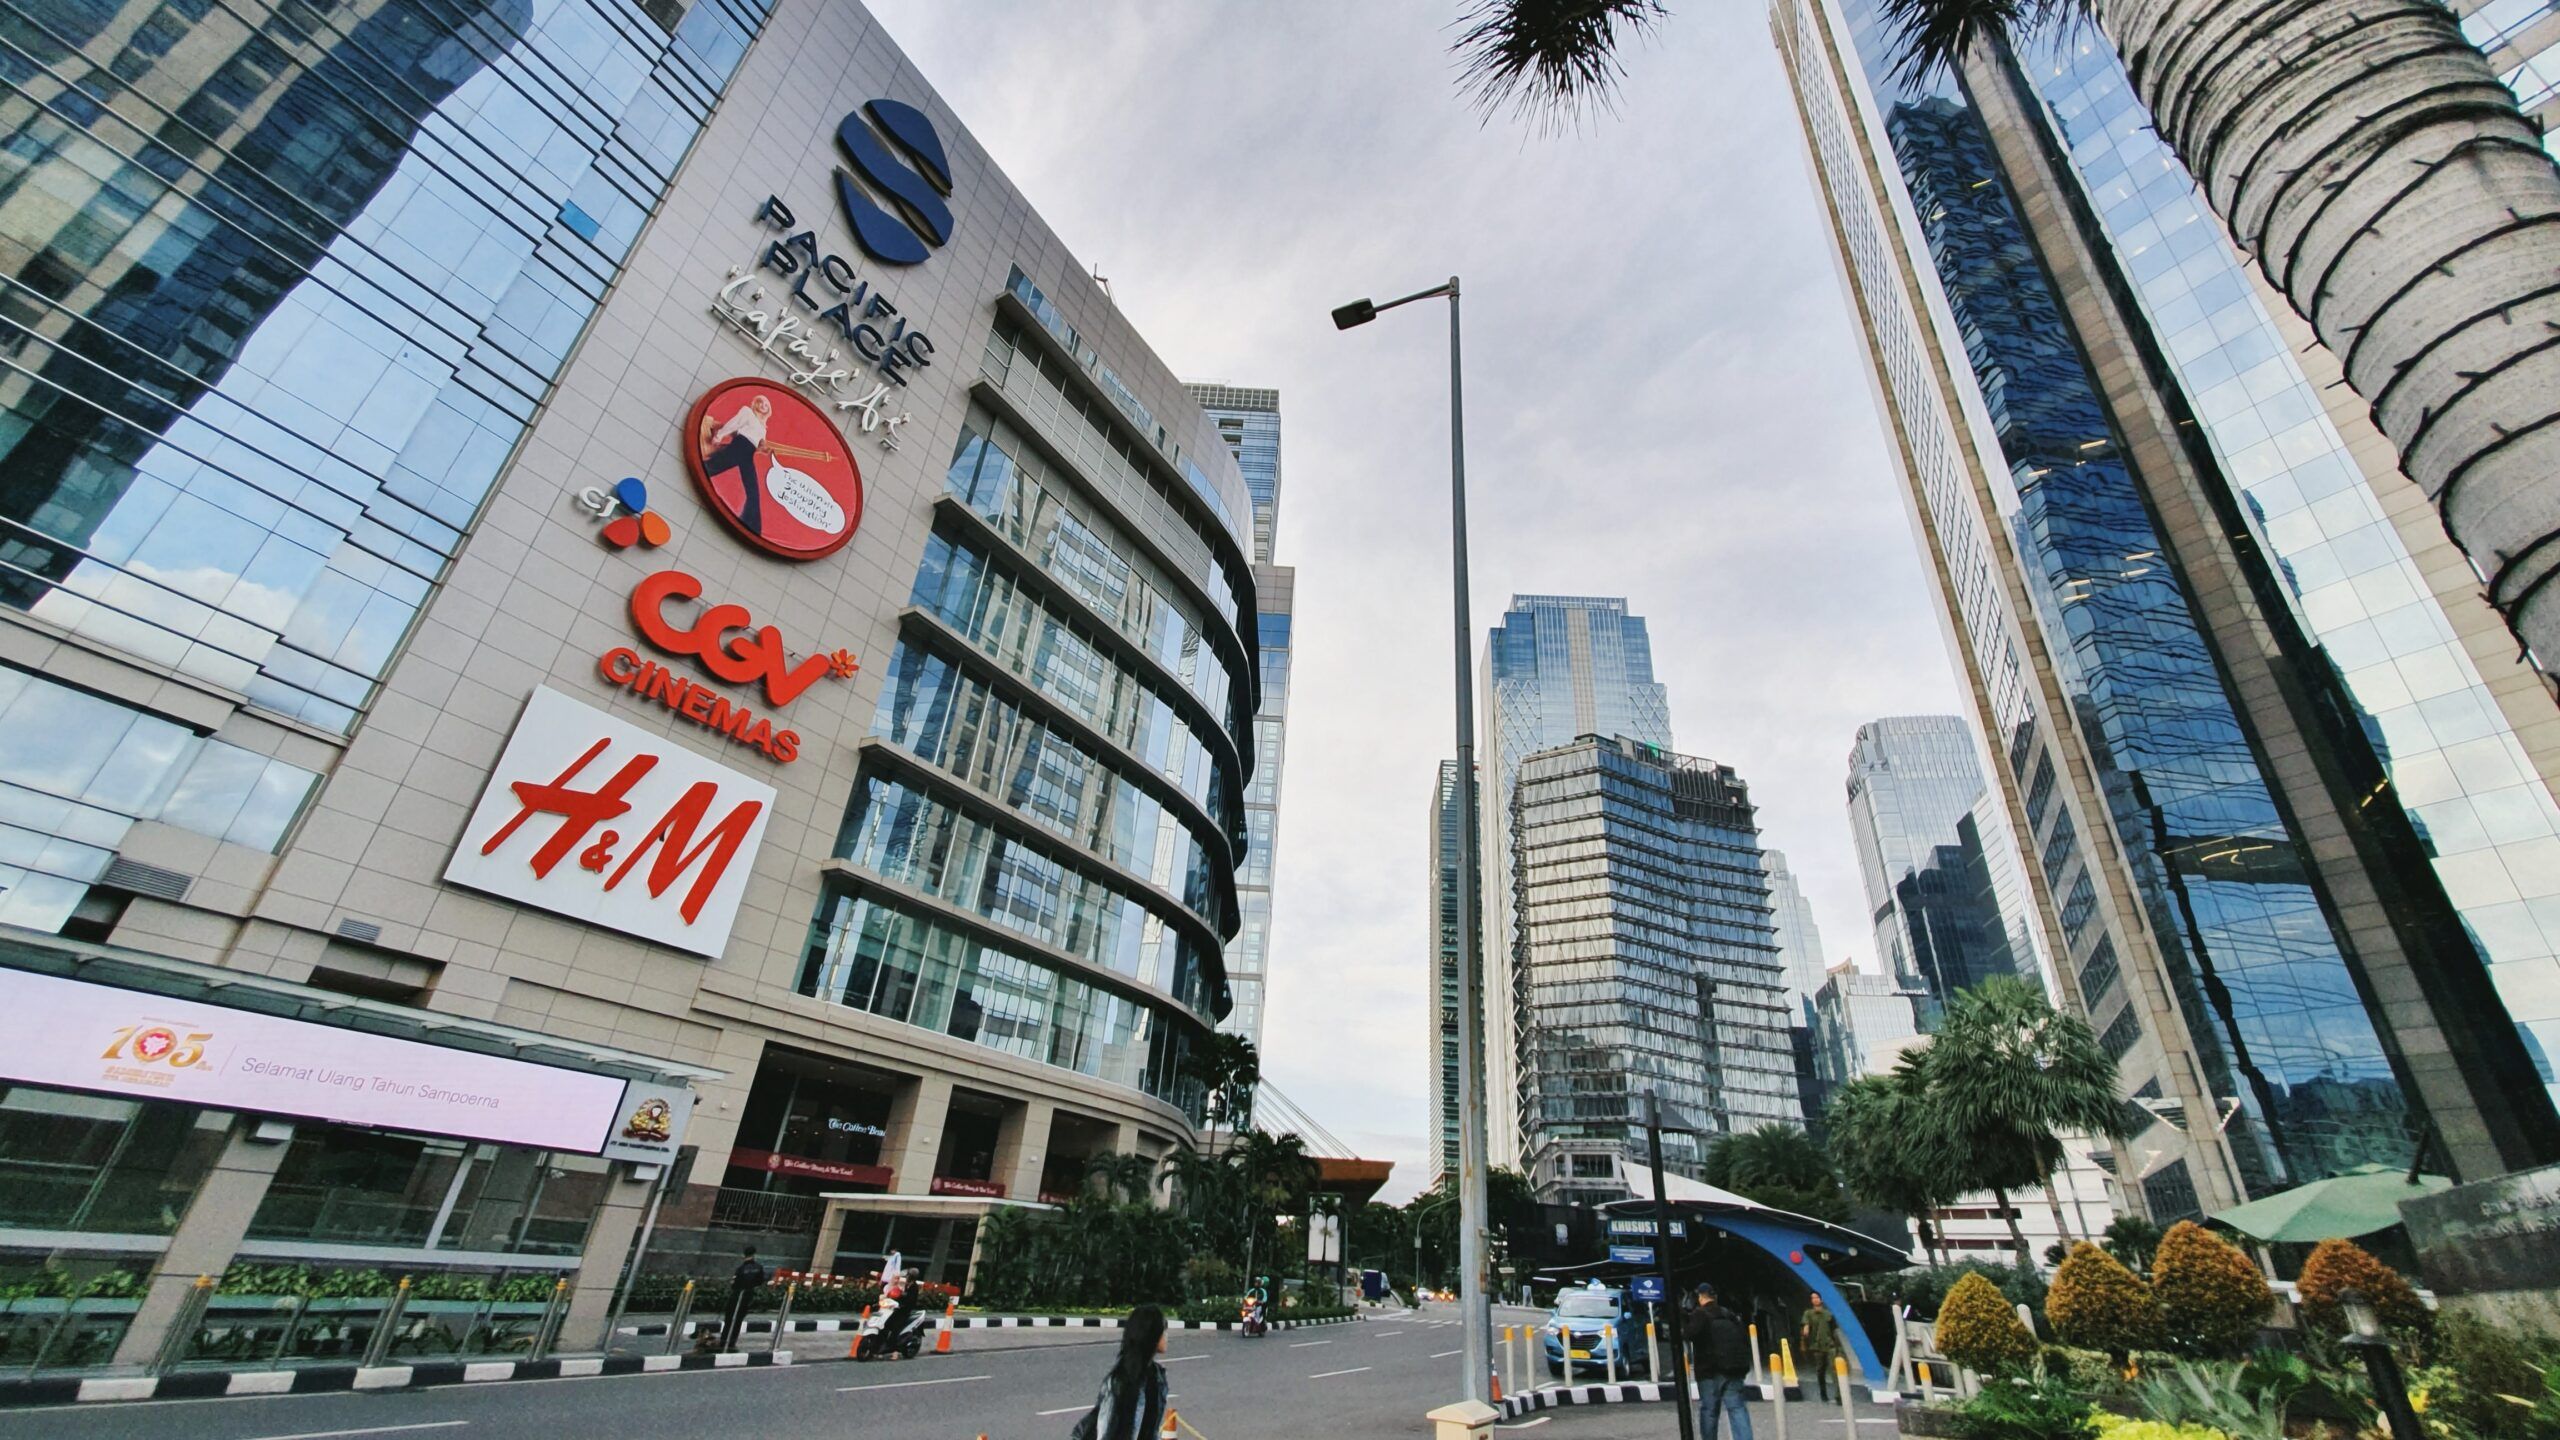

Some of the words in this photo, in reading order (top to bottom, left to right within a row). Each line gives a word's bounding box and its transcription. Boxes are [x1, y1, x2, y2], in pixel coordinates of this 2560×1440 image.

[759, 194, 935, 368] PACIFIC
[762, 240, 908, 388] PLACE
[580, 486, 620, 517] CJ
[632, 570, 830, 706] CGV
[599, 647, 801, 764] CINEMAS
[481, 737, 763, 926] H&M
[101, 1024, 213, 1067] 105
[241, 1057, 314, 1080] Selamat
[317, 1068, 365, 1091] Ulang
[370, 1077, 415, 1096] Tahun
[418, 1084, 499, 1109] Sampoerna
[1610, 1220, 1652, 1233] KHUSUS
[1652, 1221, 1683, 1235] TSI
